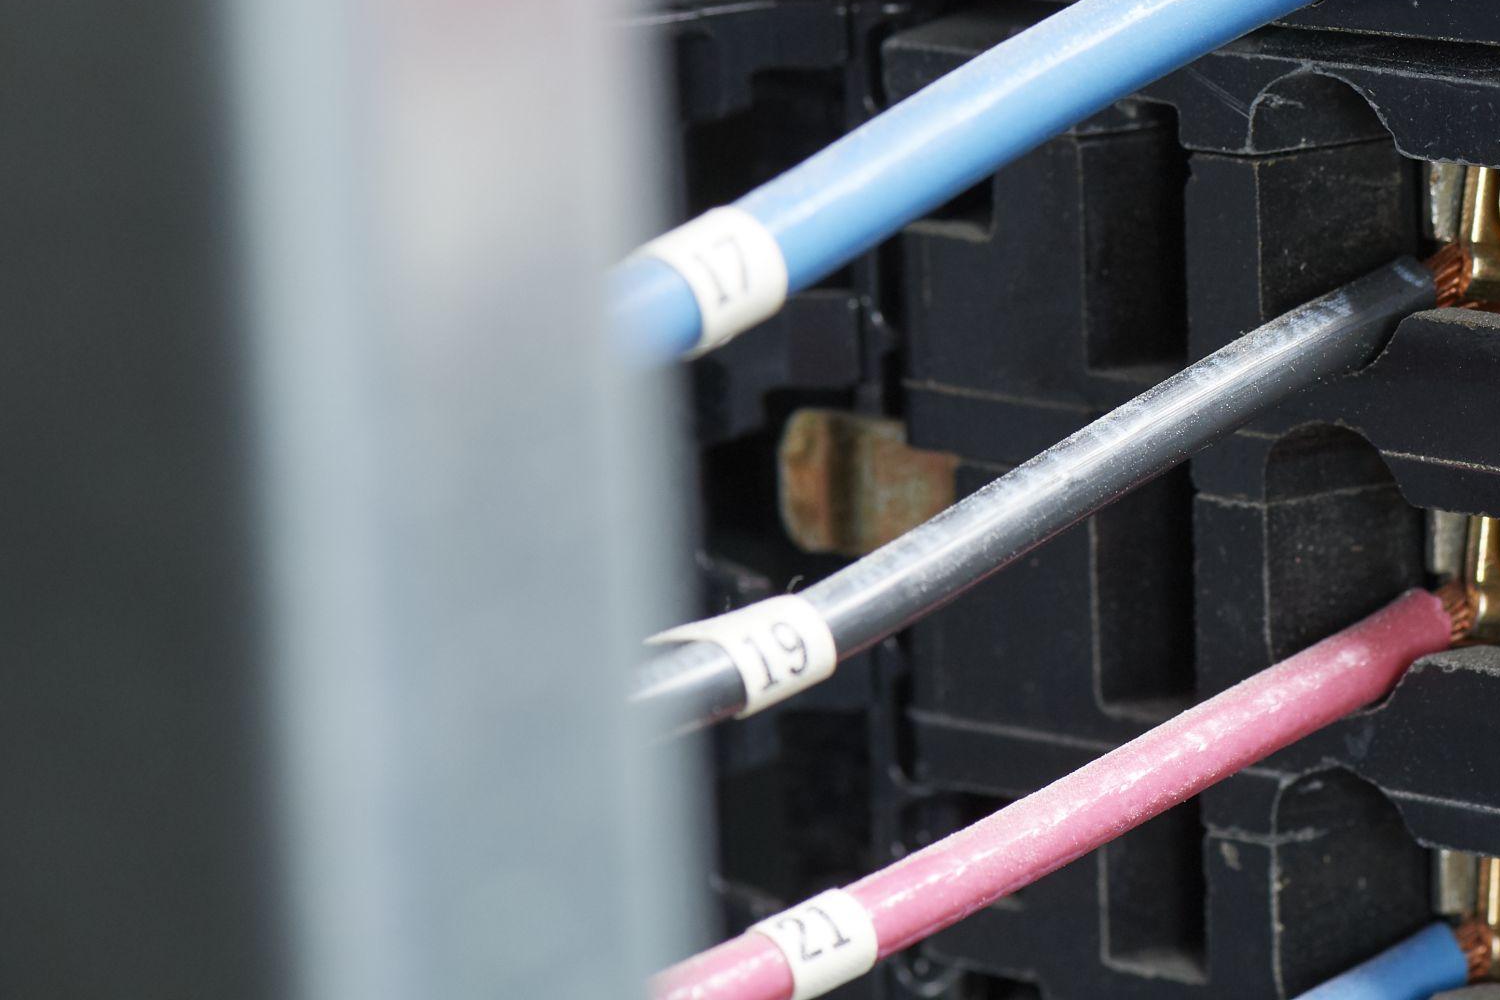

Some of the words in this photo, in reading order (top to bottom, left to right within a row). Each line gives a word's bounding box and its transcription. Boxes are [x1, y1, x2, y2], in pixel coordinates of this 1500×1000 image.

[690, 234, 755, 304] 17
[743, 620, 811, 692] 19
[776, 906, 851, 963] 21
